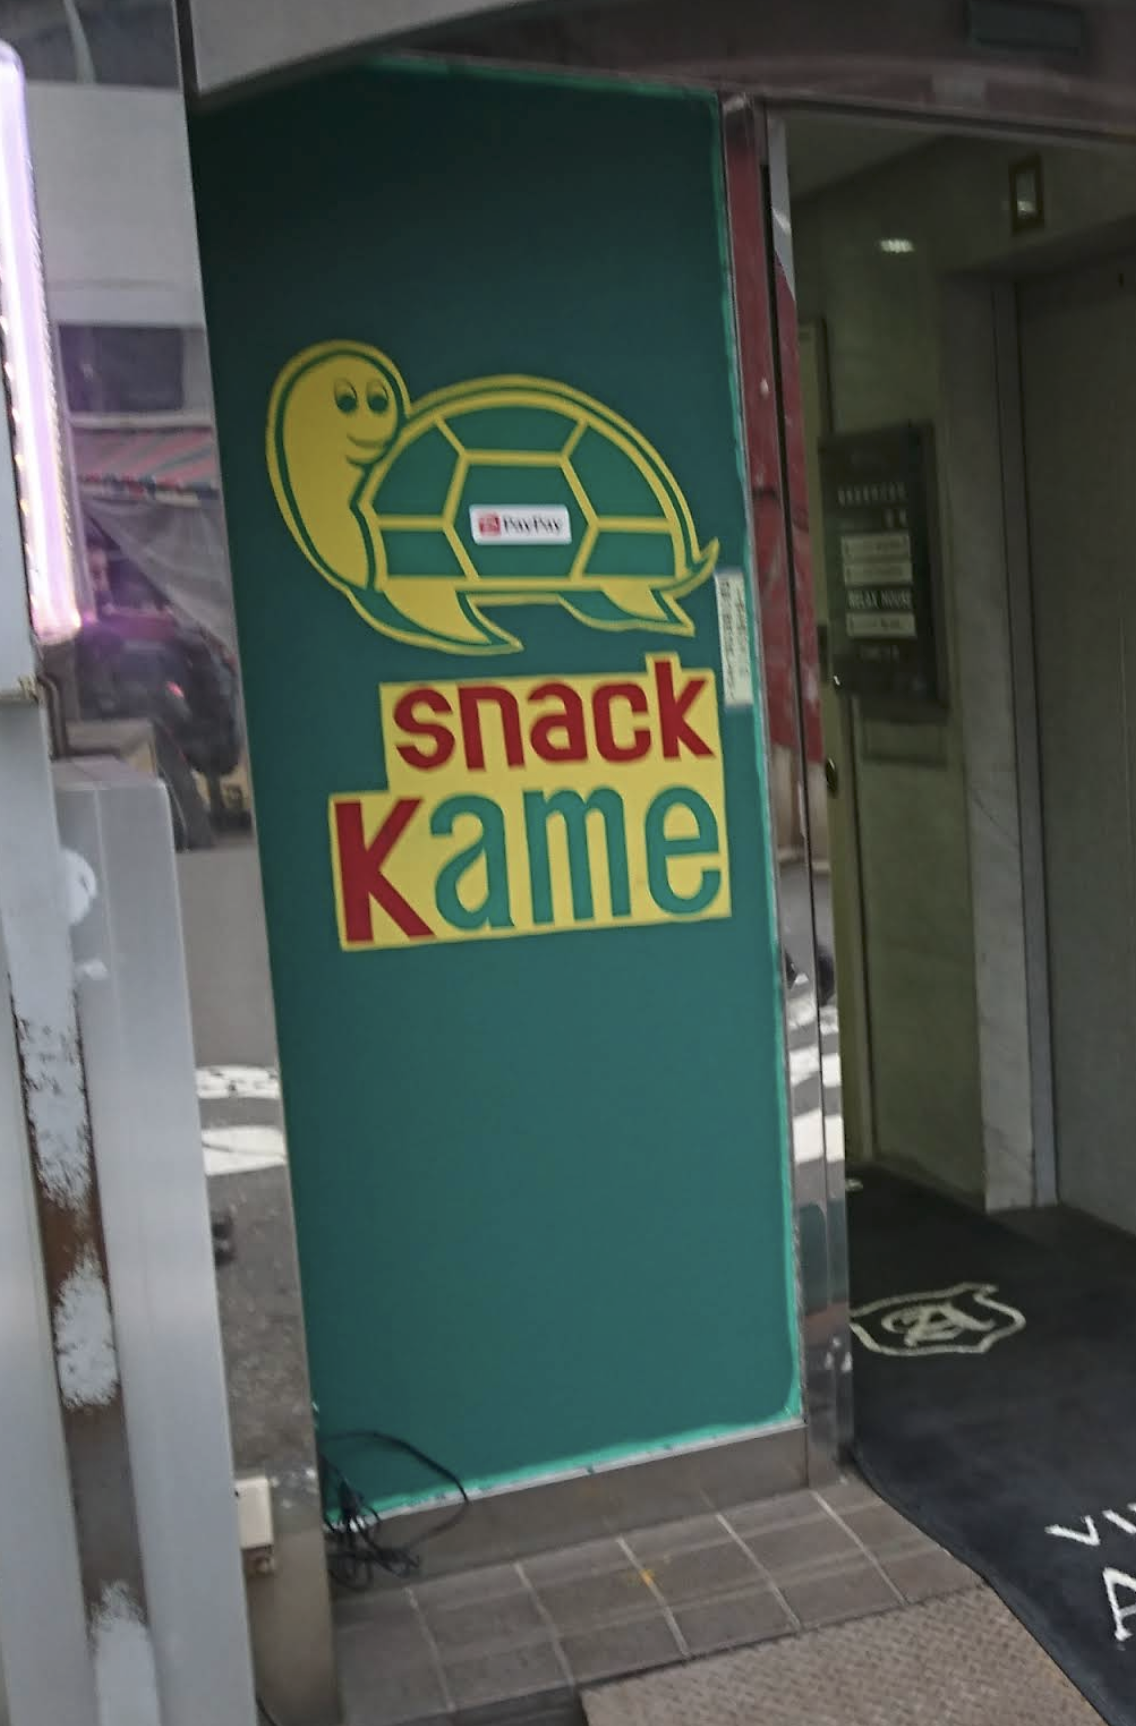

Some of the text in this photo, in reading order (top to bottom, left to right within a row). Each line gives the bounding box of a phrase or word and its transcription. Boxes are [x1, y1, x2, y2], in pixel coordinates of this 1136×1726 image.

[503, 516, 561, 534] PayPay
[393, 660, 715, 772] snack
[333, 784, 724, 944] Kame
